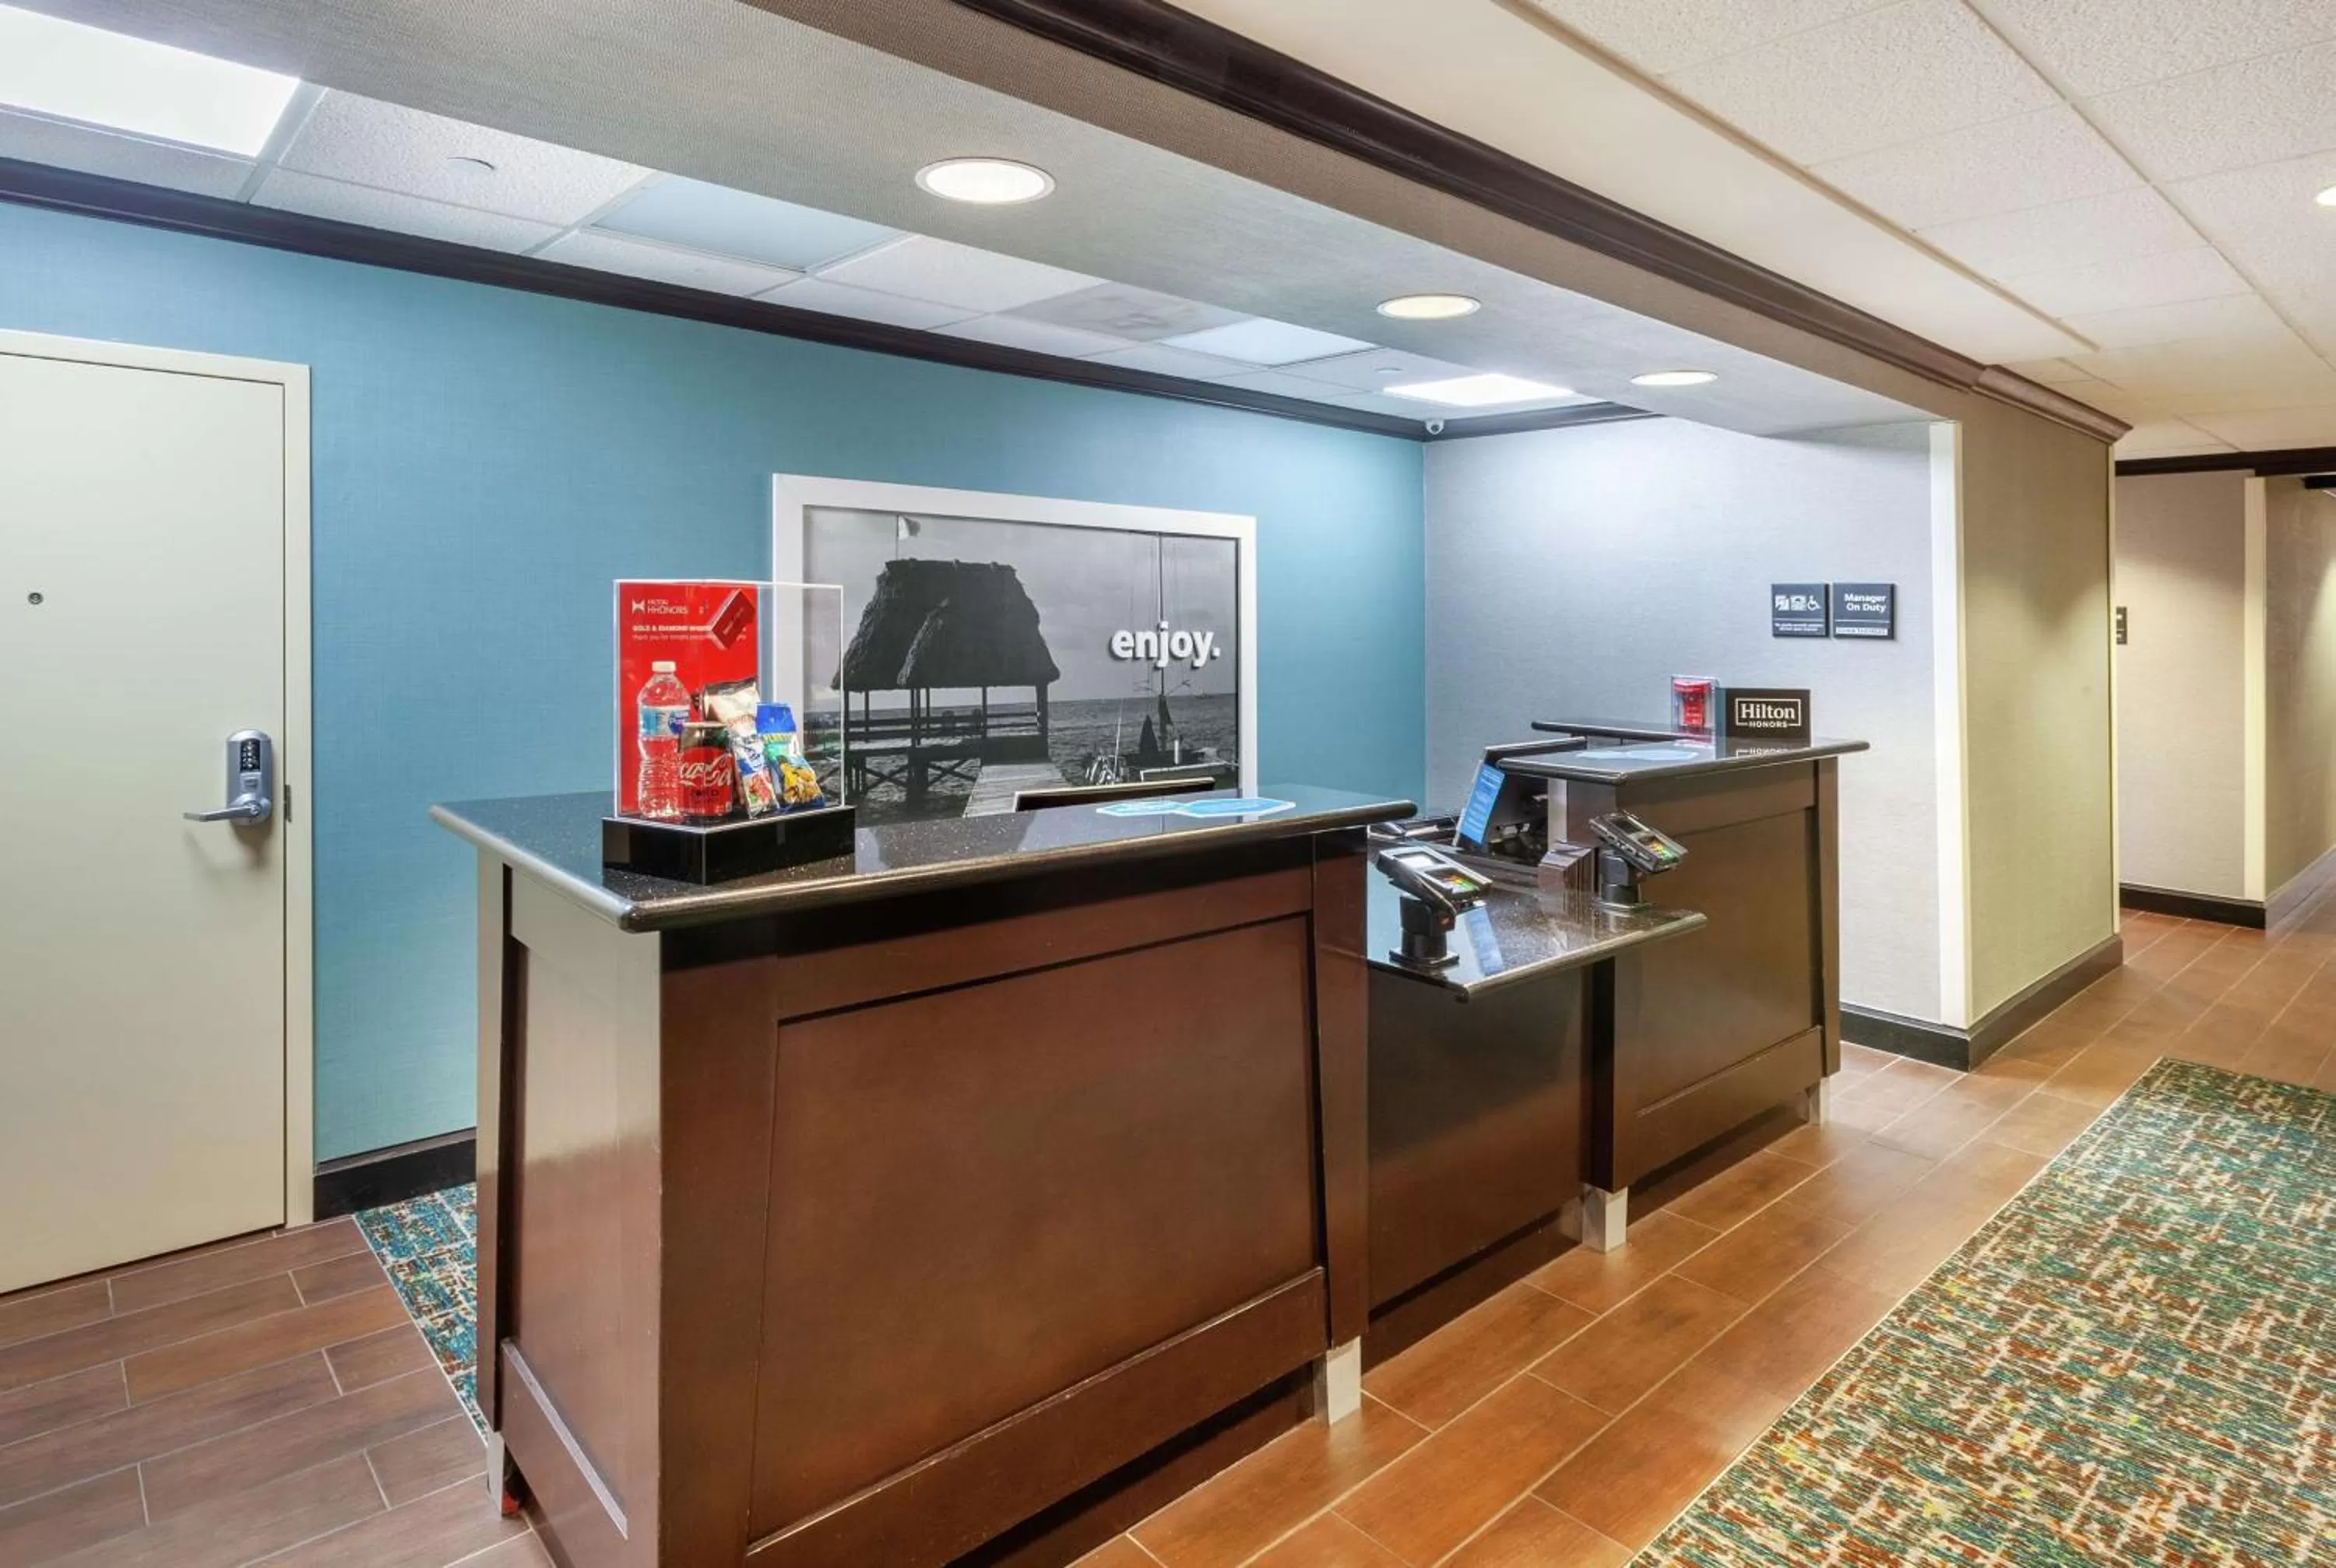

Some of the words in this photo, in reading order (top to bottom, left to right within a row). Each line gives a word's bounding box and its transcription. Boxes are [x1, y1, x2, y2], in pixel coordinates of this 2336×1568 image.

[1844, 593, 1887, 603] Manager
[1863, 603, 1887, 613] Duty
[1111, 621, 1221, 667] enjoy.
[1740, 703, 1796, 719] Hilton
